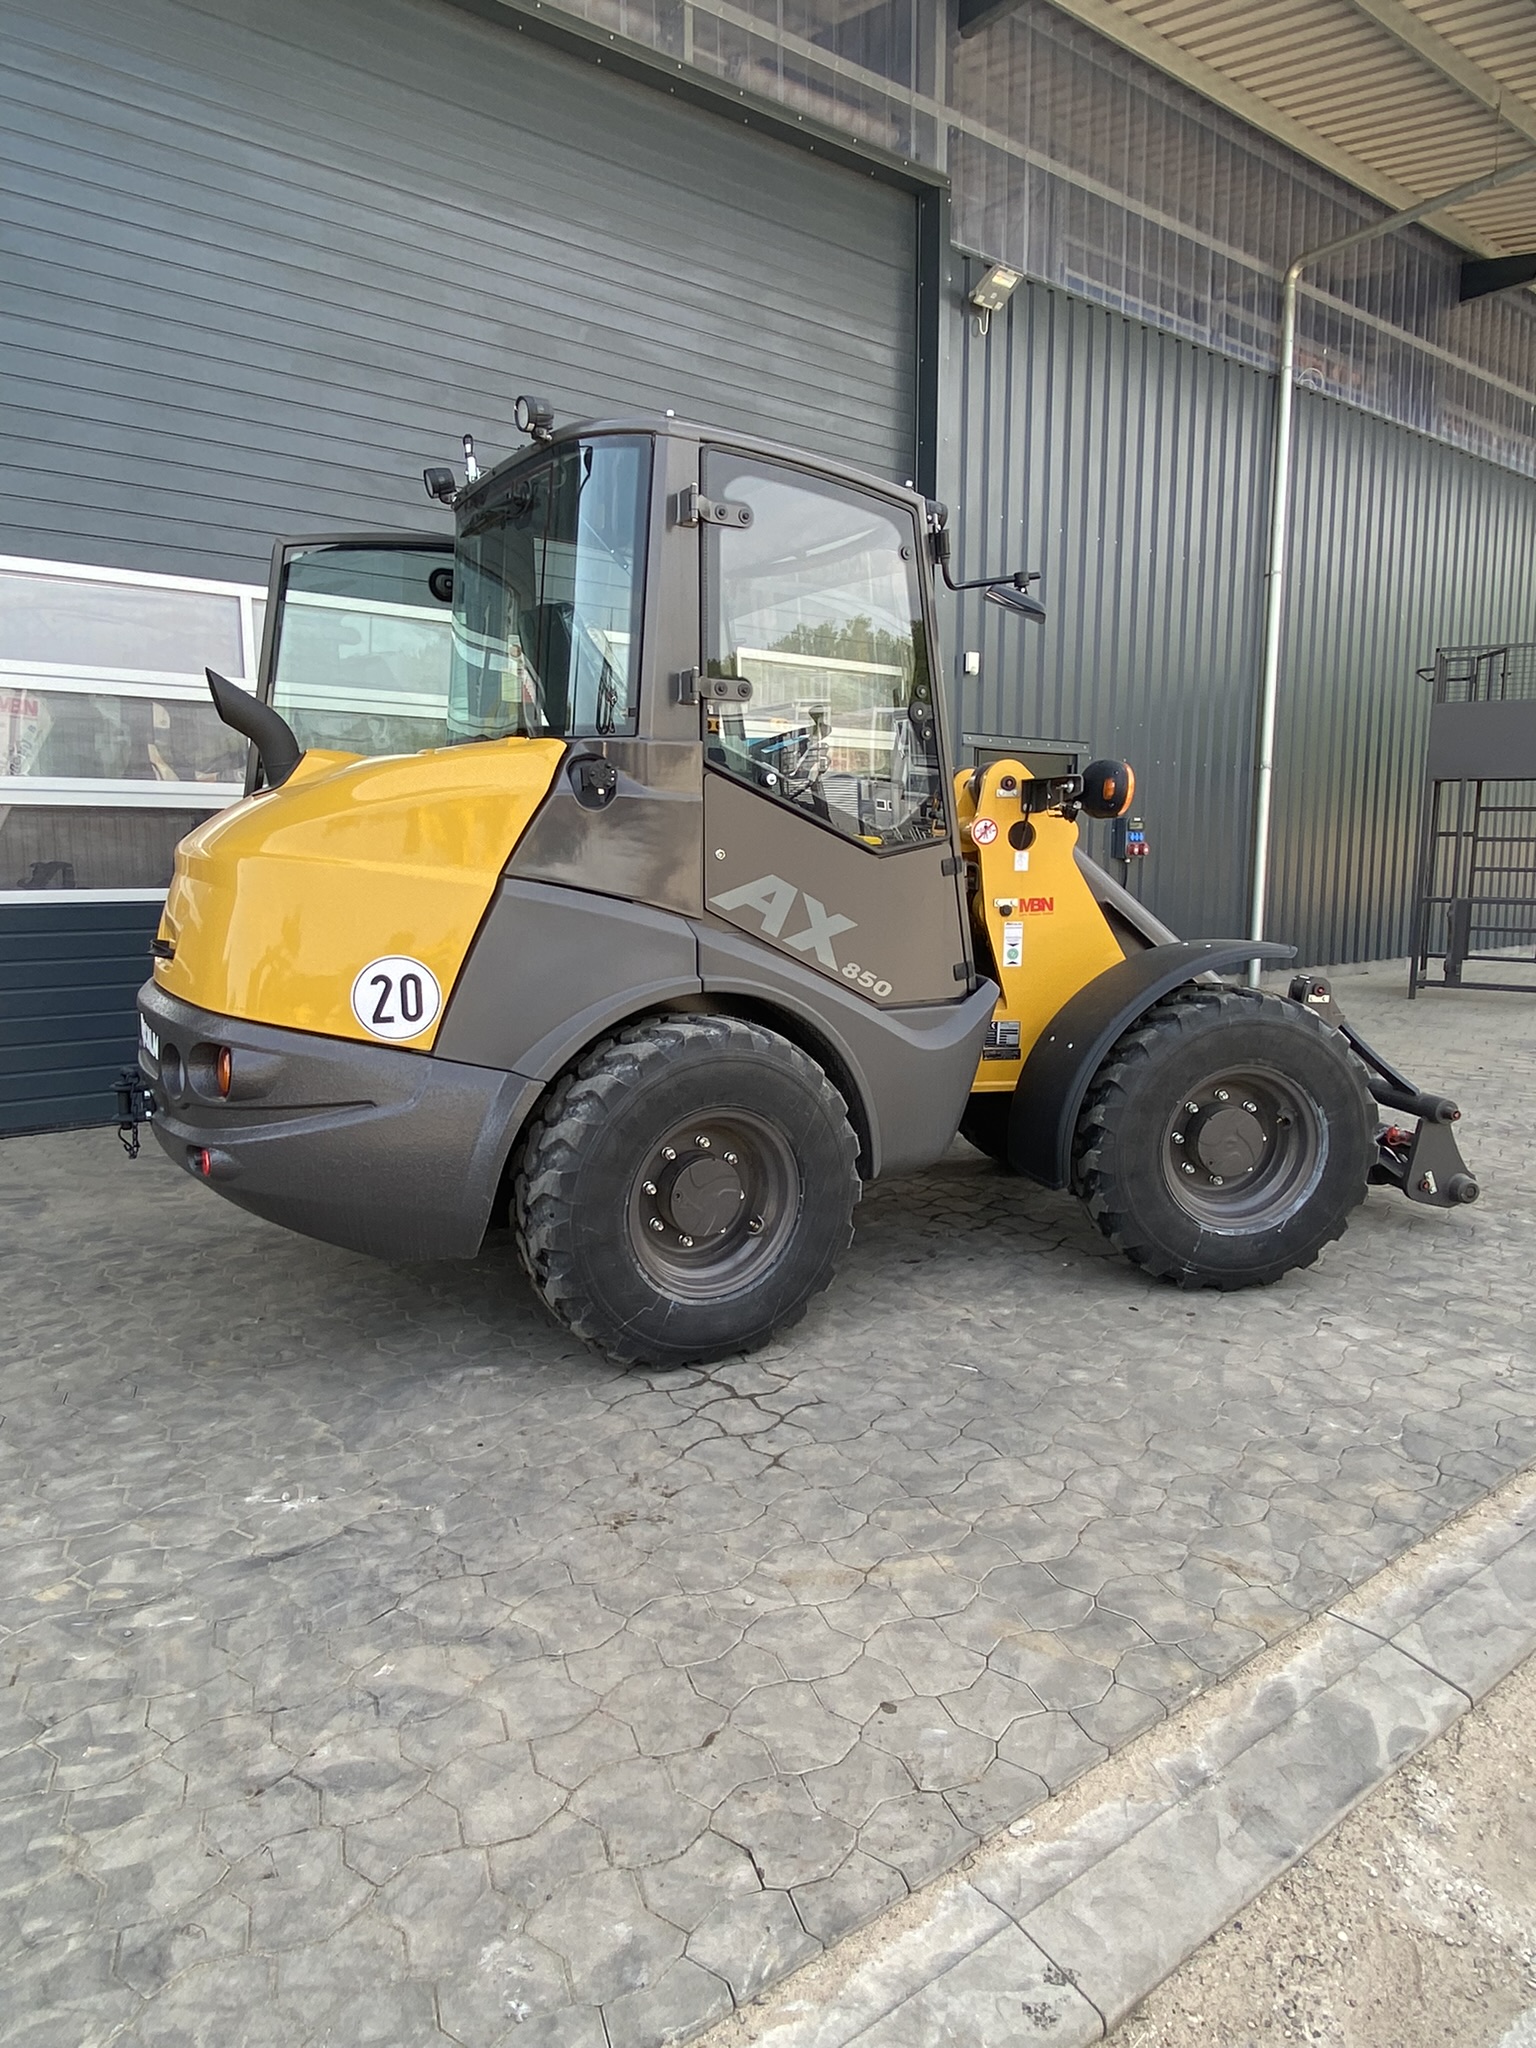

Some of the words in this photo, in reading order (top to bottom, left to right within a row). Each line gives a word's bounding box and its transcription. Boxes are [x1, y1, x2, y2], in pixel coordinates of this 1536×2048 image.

[1019, 897, 1054, 912] MBN
[709, 874, 858, 972] AX
[841, 963, 893, 997] 850
[370, 973, 423, 1024] 20
